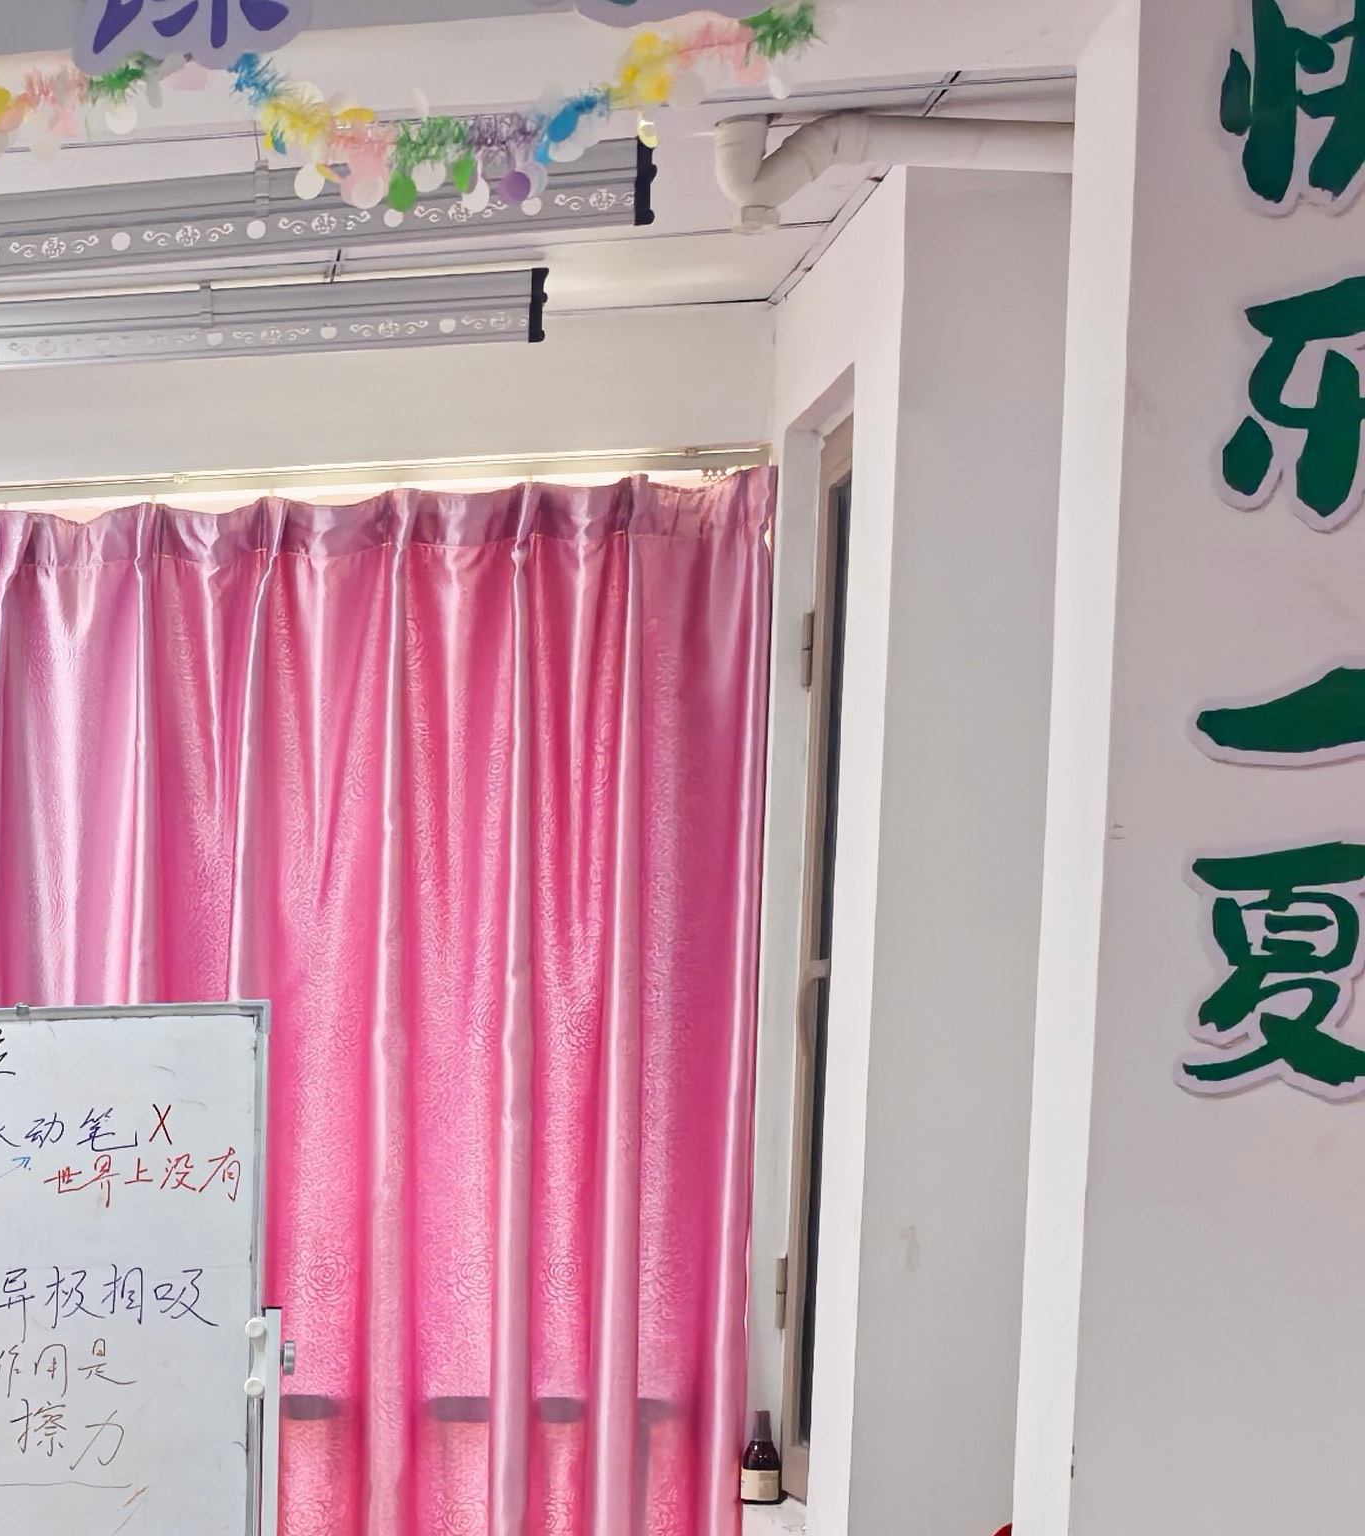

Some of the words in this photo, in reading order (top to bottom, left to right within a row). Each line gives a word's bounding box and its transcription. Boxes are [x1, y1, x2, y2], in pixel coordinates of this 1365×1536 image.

[43, 1146, 243, 1208] 世界上没有
